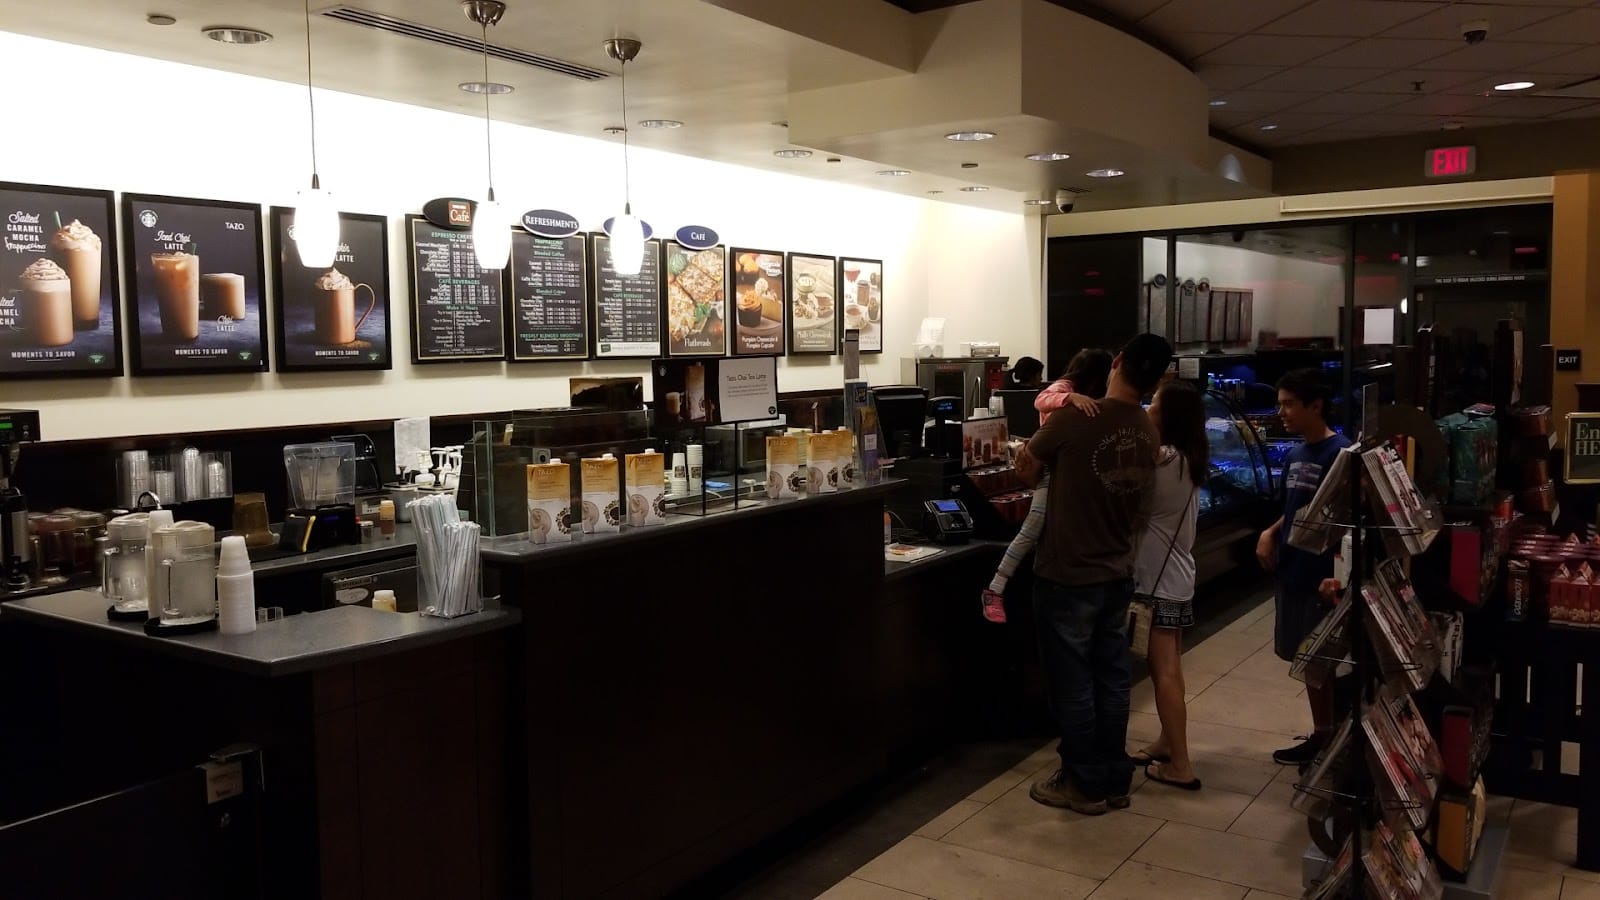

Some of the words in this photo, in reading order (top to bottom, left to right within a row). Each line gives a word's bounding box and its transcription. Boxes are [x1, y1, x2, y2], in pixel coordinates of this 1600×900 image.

[1433, 148, 1468, 175] EXIT
[9, 211, 40, 223] Salted
[225, 221, 245, 230] TAZO
[525, 215, 578, 229] REFRESHMENTS
[7, 224, 43, 233] CARAMEL
[12, 233, 40, 242] MOCHA
[154, 230, 174, 241] Iced
[174, 232, 191, 243] Chai
[335, 254, 355, 262] LATTE
[684, 338, 711, 347] Flatbreads
[1558, 356, 1577, 364] EXIT
